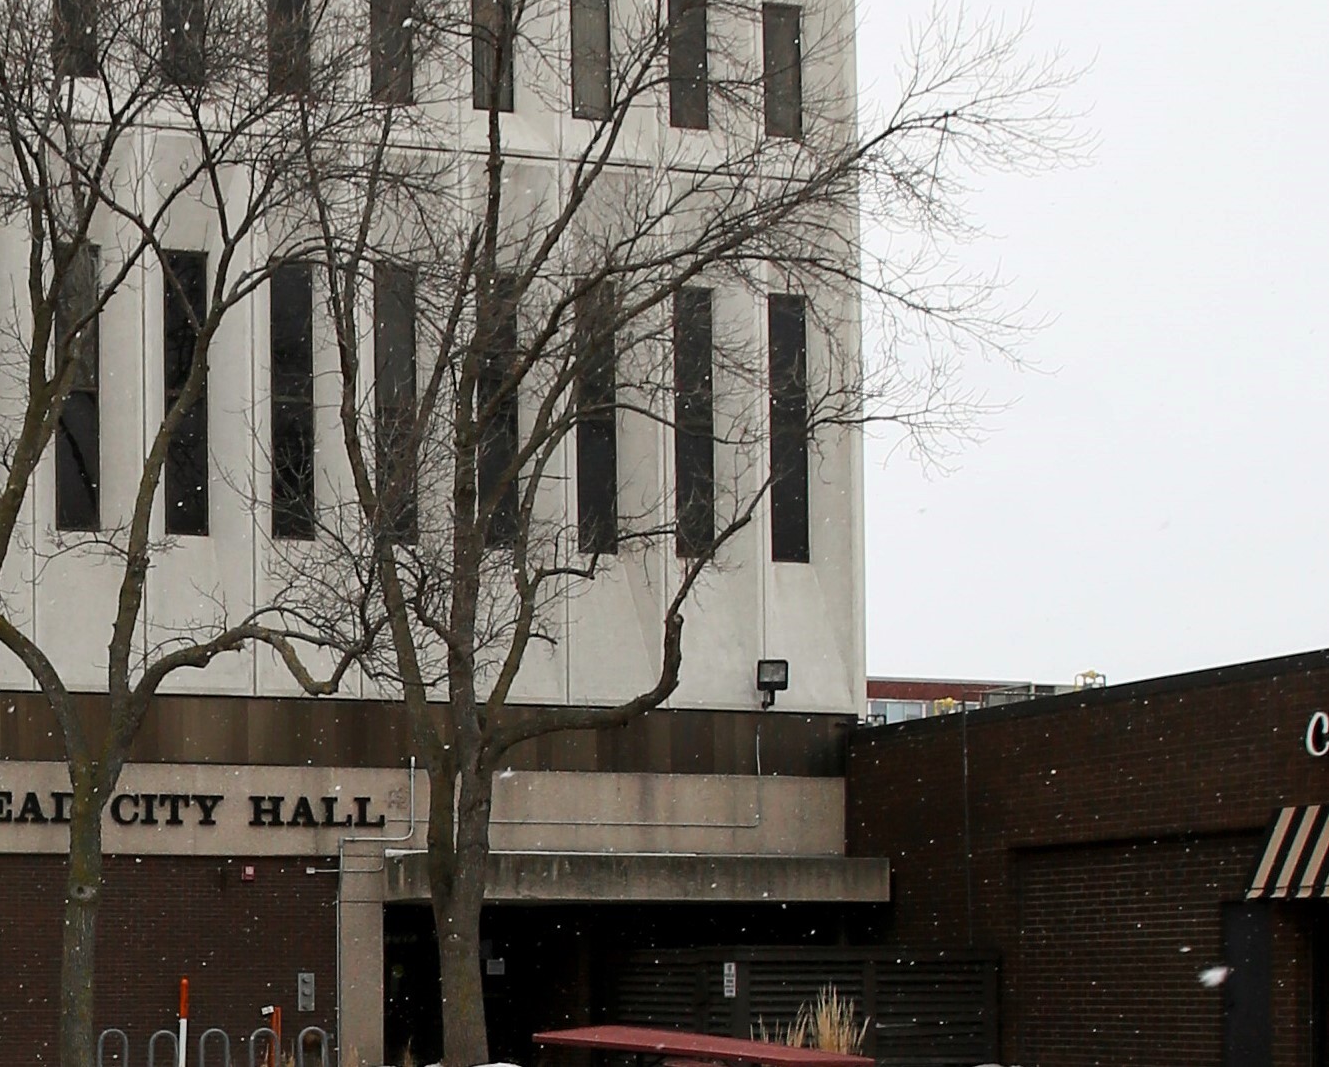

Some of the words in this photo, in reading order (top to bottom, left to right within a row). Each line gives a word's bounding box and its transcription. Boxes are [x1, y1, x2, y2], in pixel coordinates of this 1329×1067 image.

[1306, 712, 1329, 756] C
[110, 794, 224, 825] CITY
[248, 796, 385, 827] HALL
